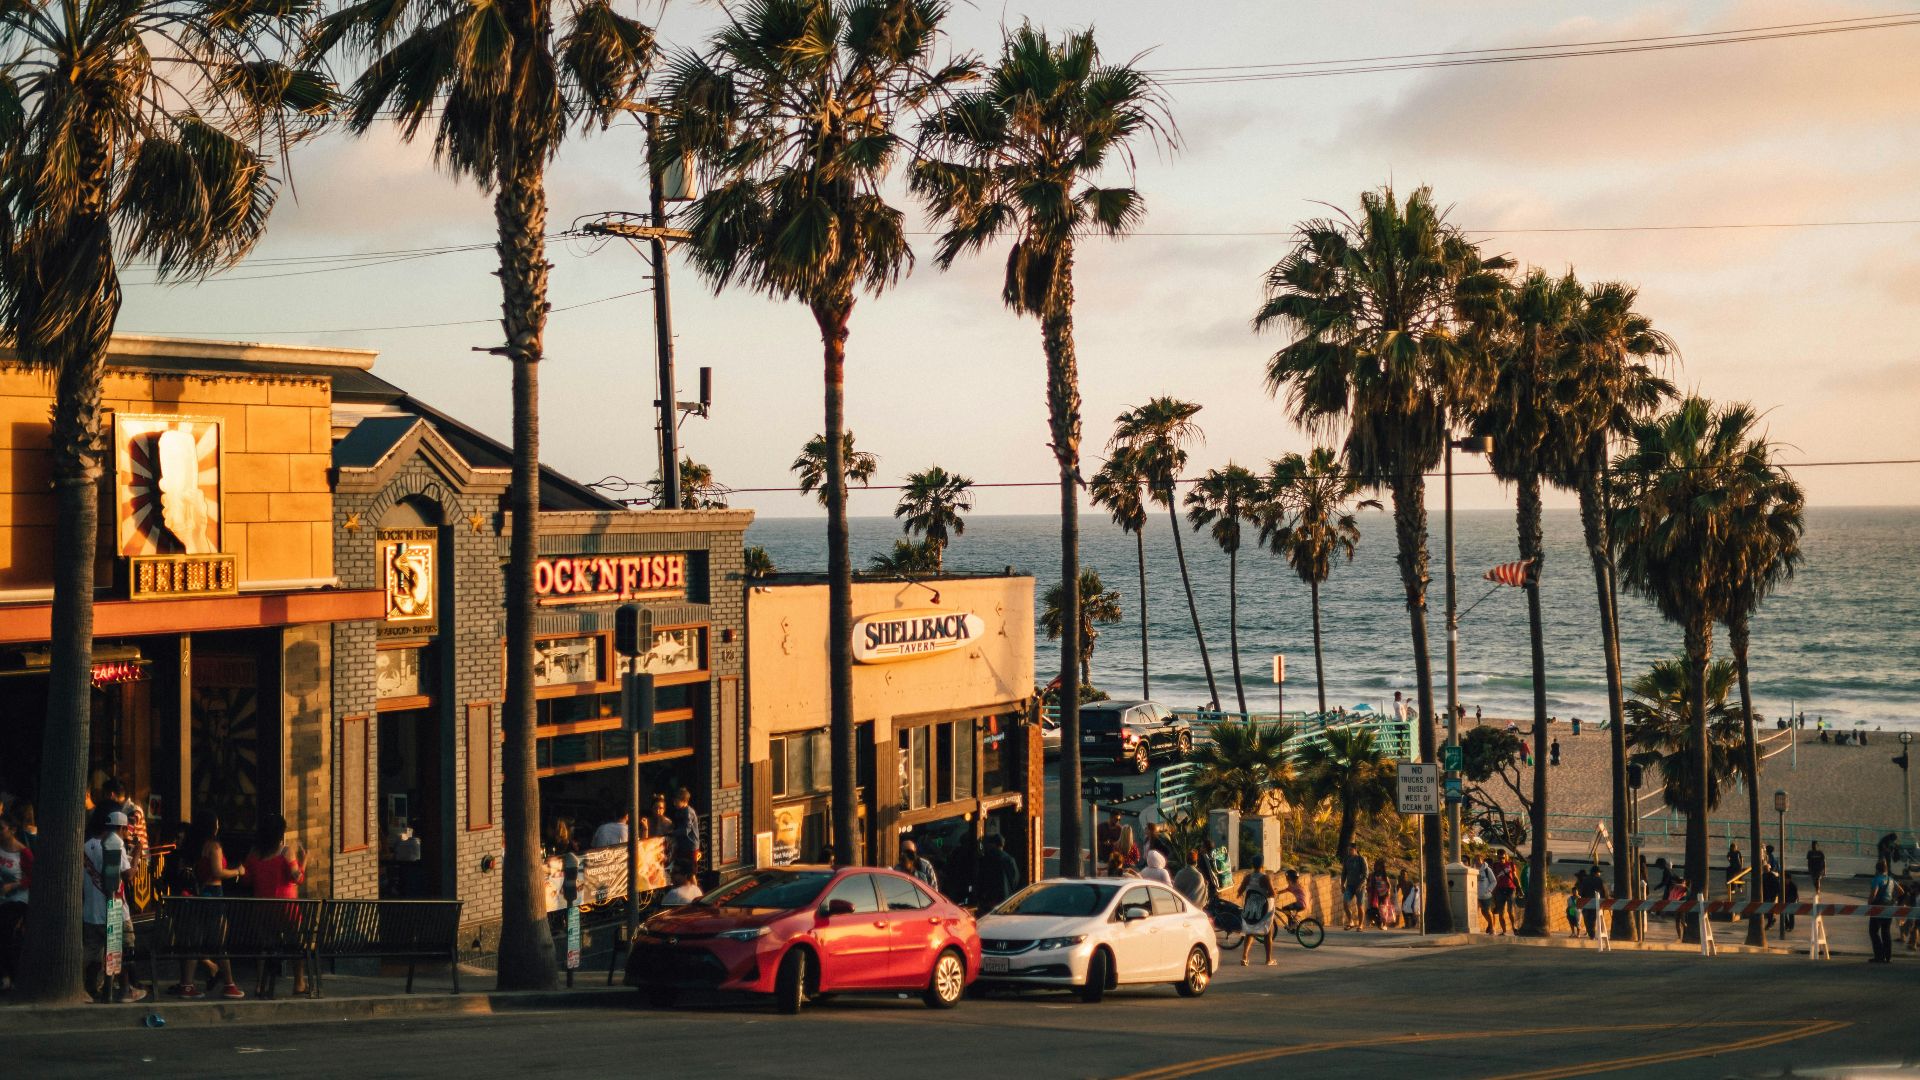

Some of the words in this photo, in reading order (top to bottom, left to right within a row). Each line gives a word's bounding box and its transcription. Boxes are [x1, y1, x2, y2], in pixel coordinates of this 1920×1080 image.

[416, 529, 436, 540] FISH
[139, 560, 233, 593] BREWCO
[865, 613, 970, 650] SHELLBACK
[899, 641, 935, 654] TAVERN
[1411, 766, 1423, 774] NO
[1407, 785, 1428, 793] BUSES
